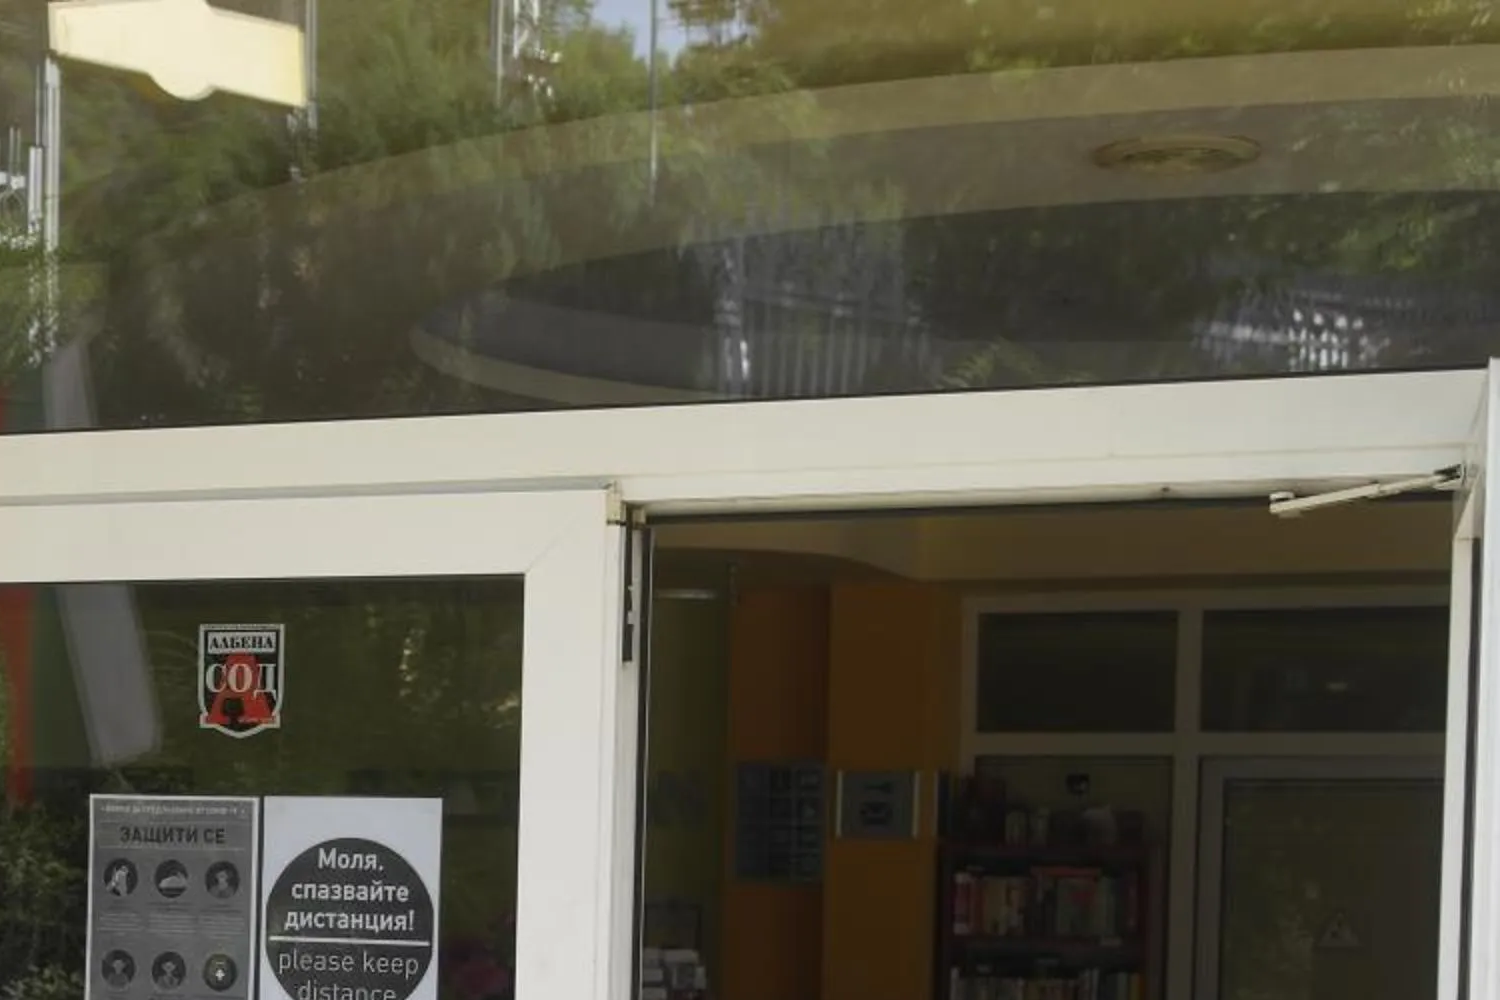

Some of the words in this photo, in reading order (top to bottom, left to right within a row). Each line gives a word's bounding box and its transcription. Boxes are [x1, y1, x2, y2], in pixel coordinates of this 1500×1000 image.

[206, 663, 276, 701] СОД
[120, 826, 198, 844] ЗАЩИТИ
[204, 828, 225, 844] СЕ
[291, 880, 409, 902] спазвайте
[284, 910, 415, 933] дистанция!
[278, 948, 355, 975] please
[363, 949, 419, 980] keep
